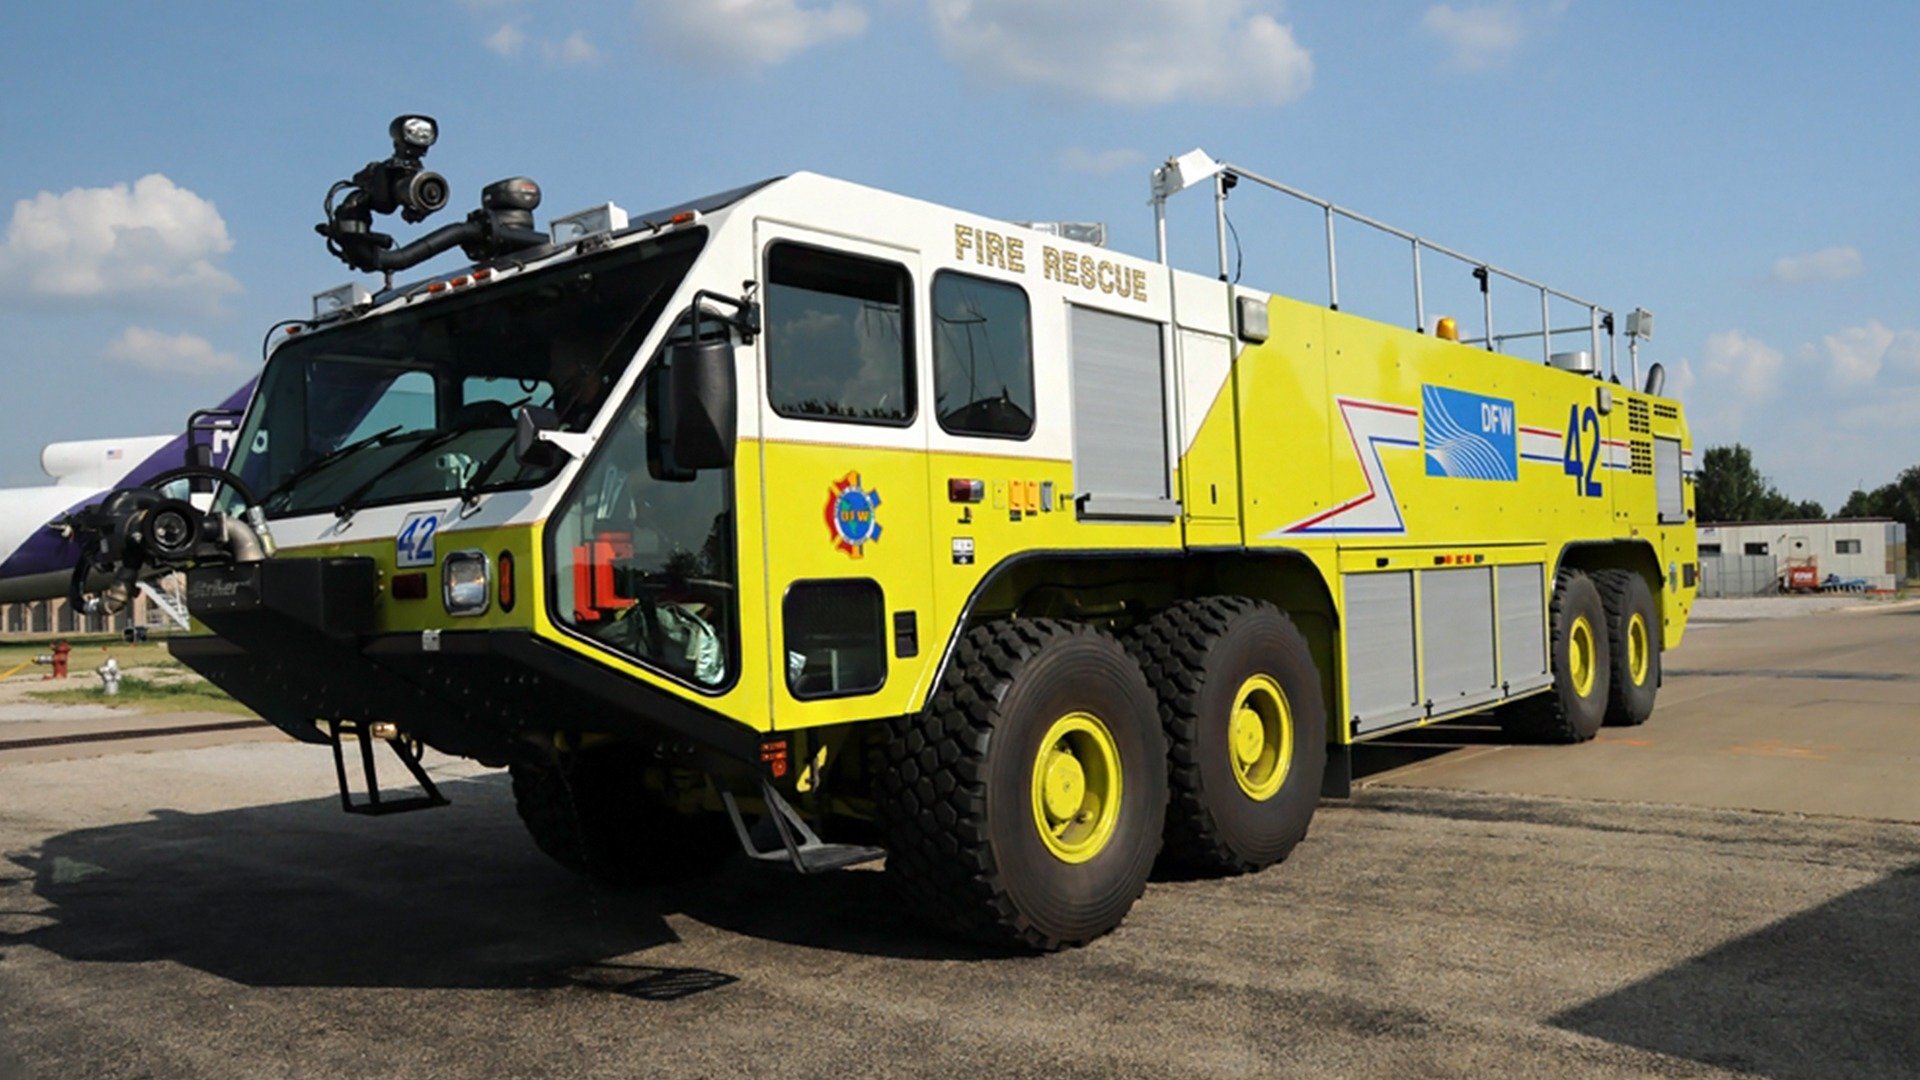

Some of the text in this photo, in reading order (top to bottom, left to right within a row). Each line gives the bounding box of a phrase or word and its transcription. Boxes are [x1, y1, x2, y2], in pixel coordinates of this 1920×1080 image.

[955, 223, 1148, 303] FIRE RESCUE
[1481, 402, 1512, 436] DFW
[1564, 404, 1602, 497] 42
[398, 515, 437, 561] 42
